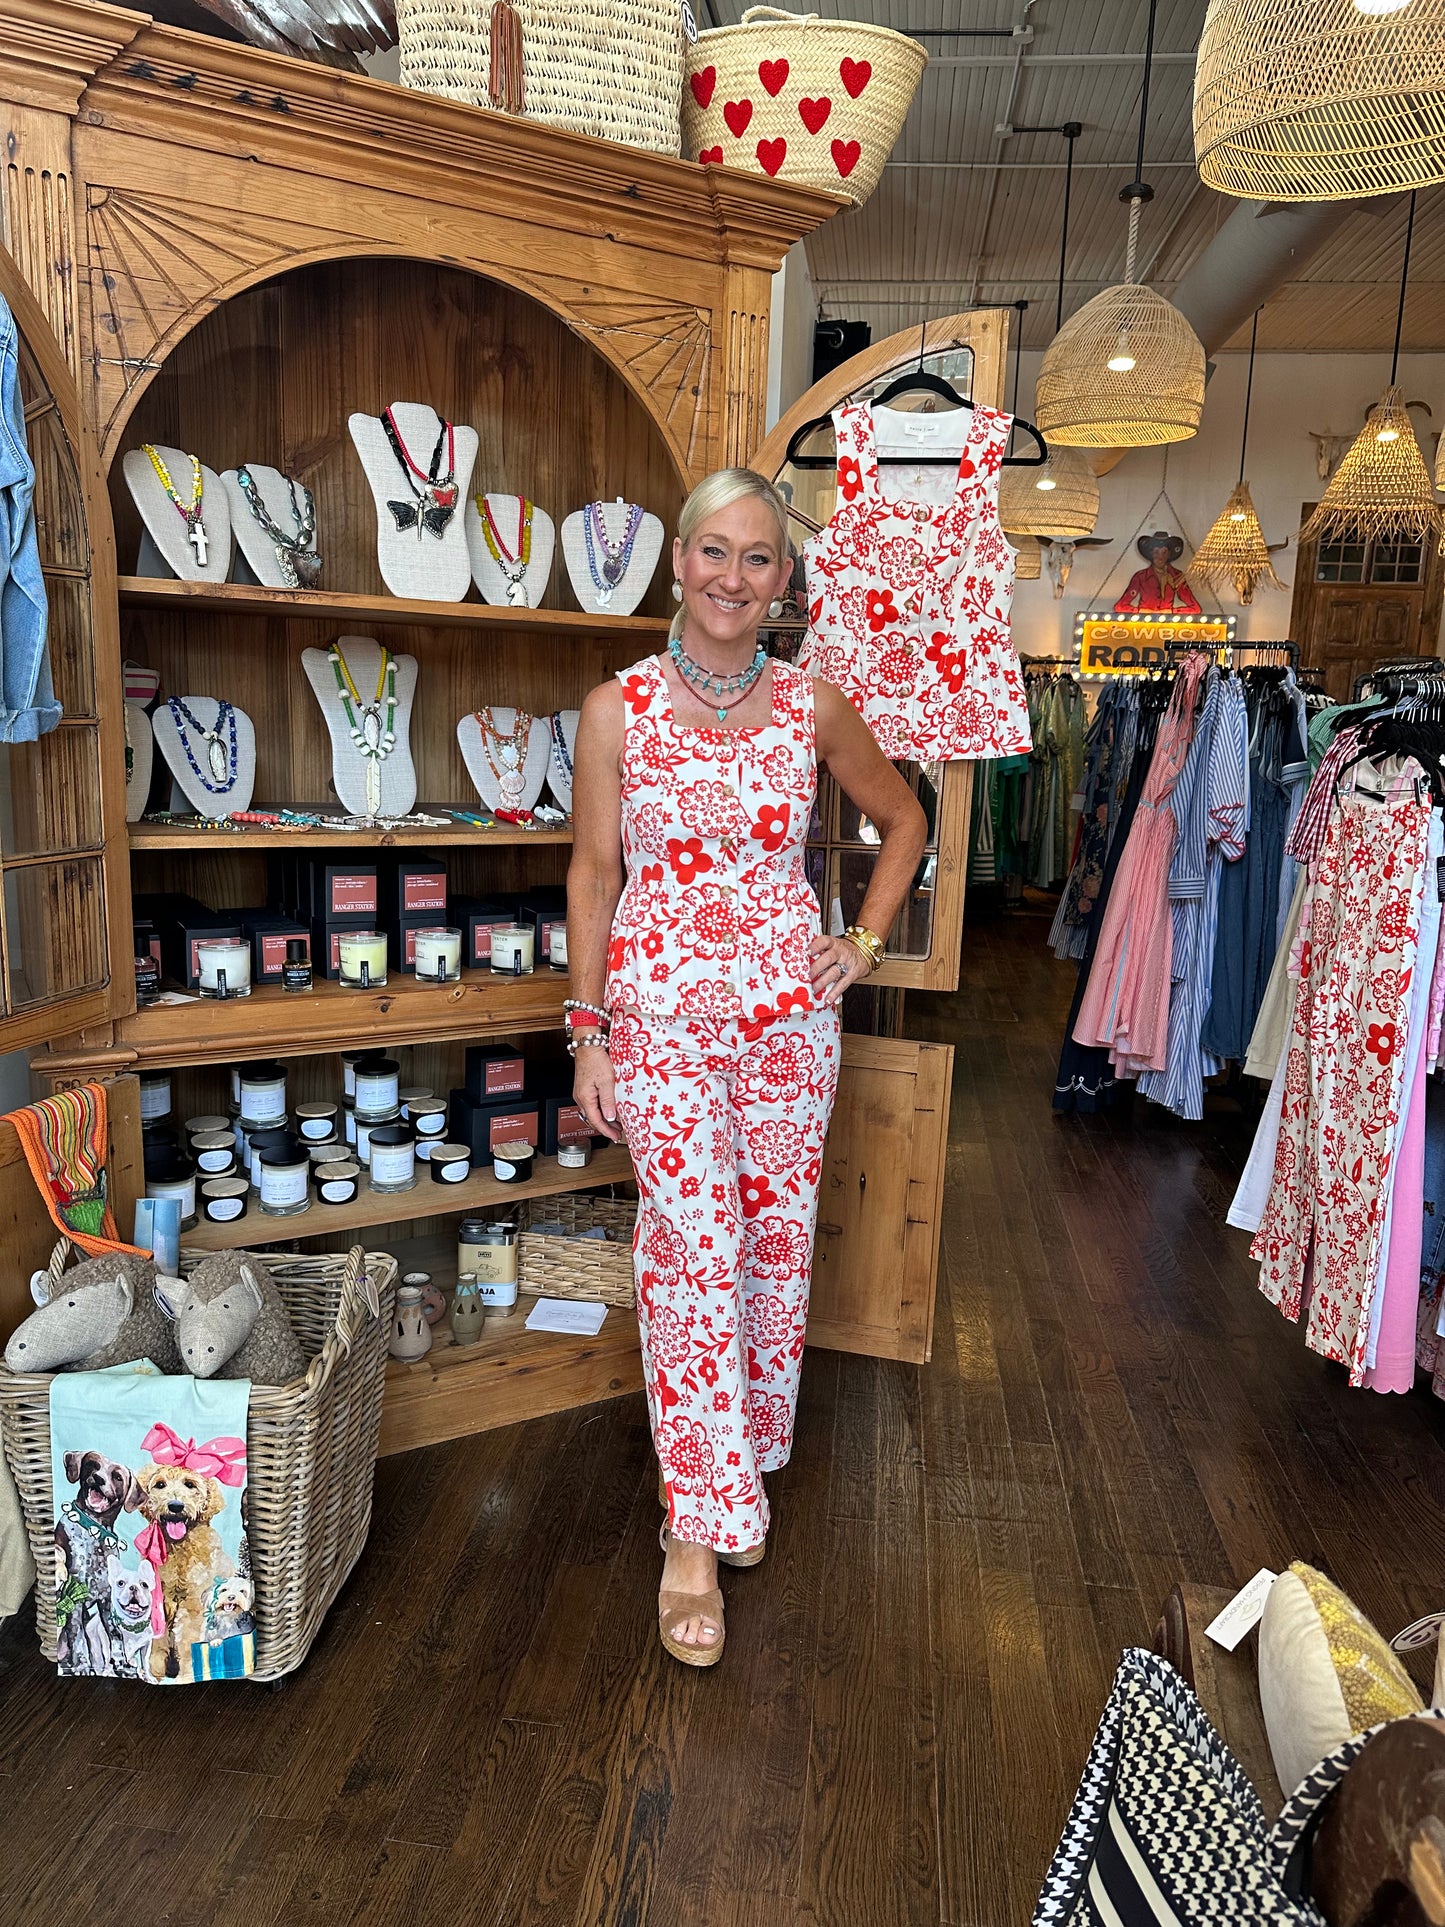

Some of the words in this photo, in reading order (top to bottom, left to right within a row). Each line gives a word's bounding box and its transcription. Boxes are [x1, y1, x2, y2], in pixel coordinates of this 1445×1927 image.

[1090, 626, 1220, 641] COWBOY
[1088, 645, 1206, 667] RODE
[335, 903, 354, 911] RANGER
[407, 901, 425, 909] RANGER
[266, 963, 282, 971] RANG
[487, 1085, 504, 1093] RANGER
[479, 1288, 496, 1296] AJA
